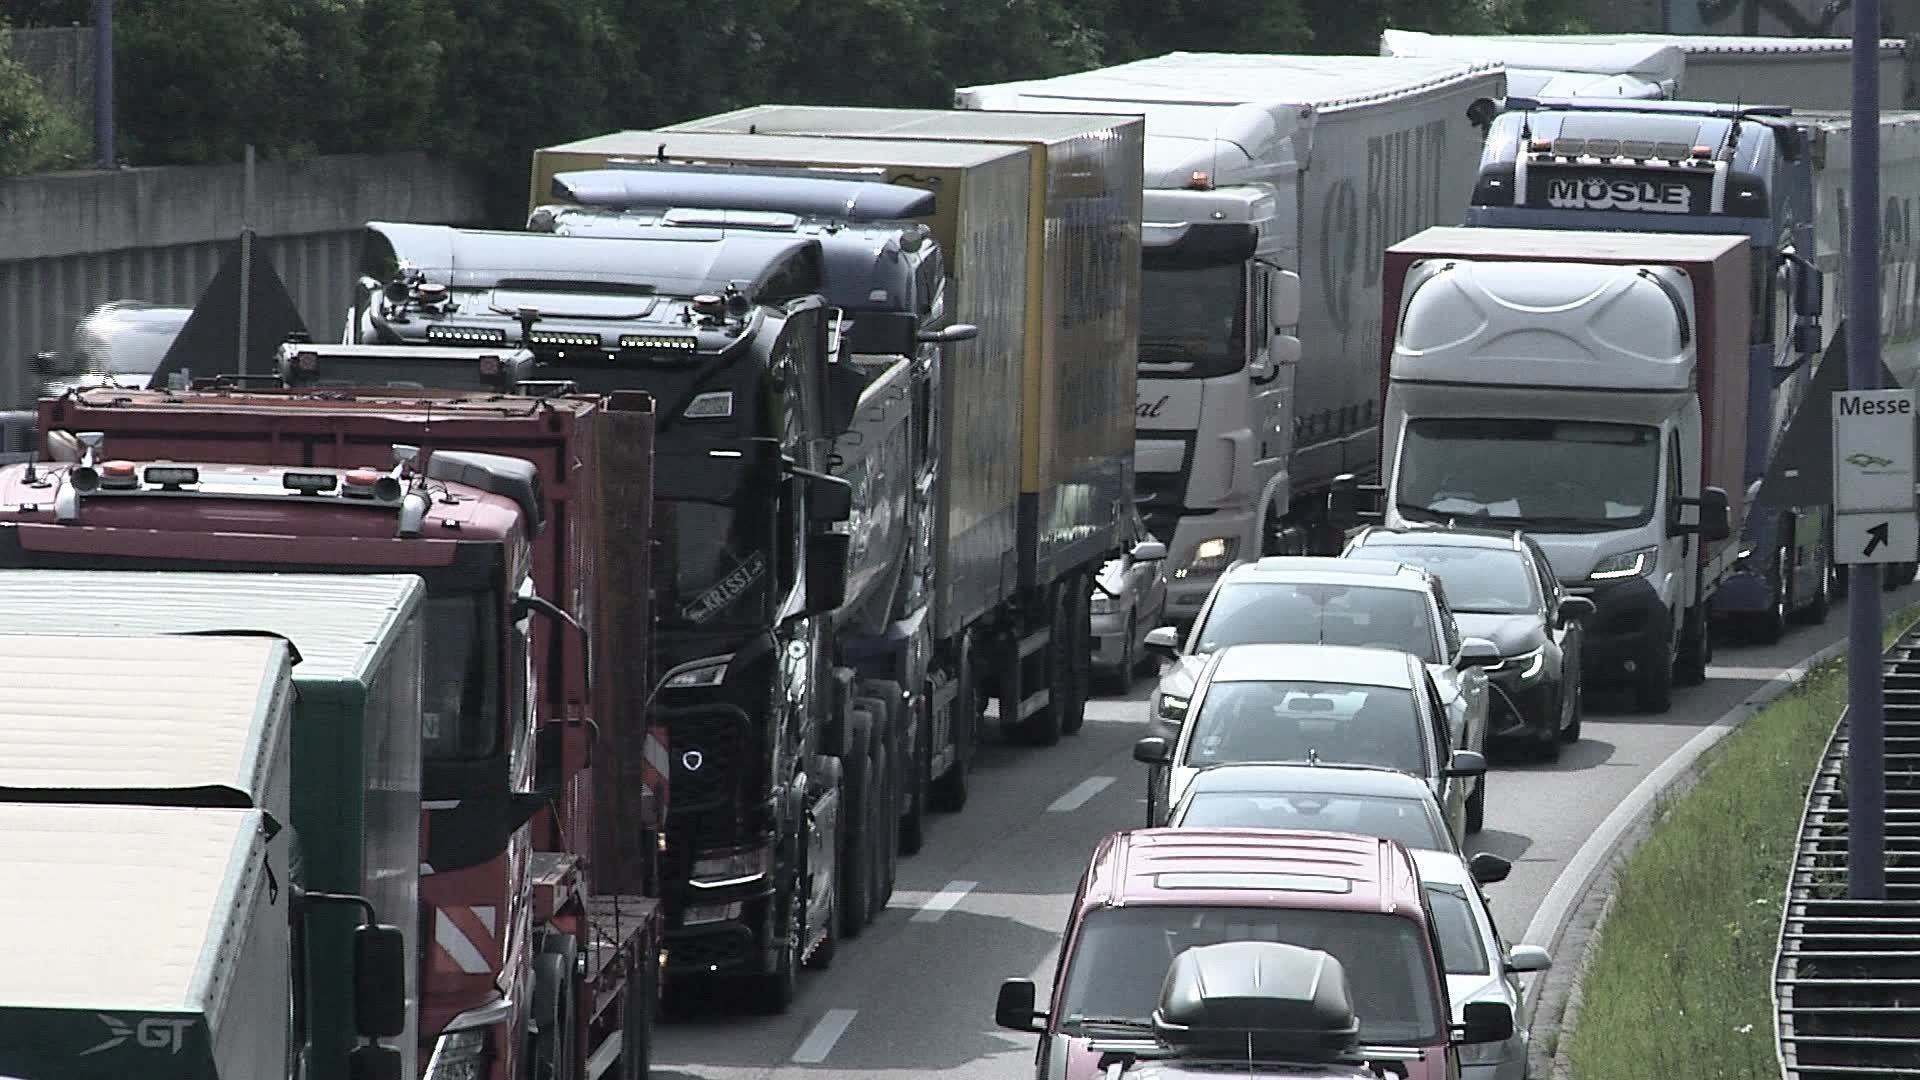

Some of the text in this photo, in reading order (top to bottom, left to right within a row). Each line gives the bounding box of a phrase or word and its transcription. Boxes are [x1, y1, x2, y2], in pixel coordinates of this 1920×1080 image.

[1549, 177, 1692, 213] MÖSLE
[1839, 396, 1911, 417] Messe
[137, 1018, 198, 1055] GT
